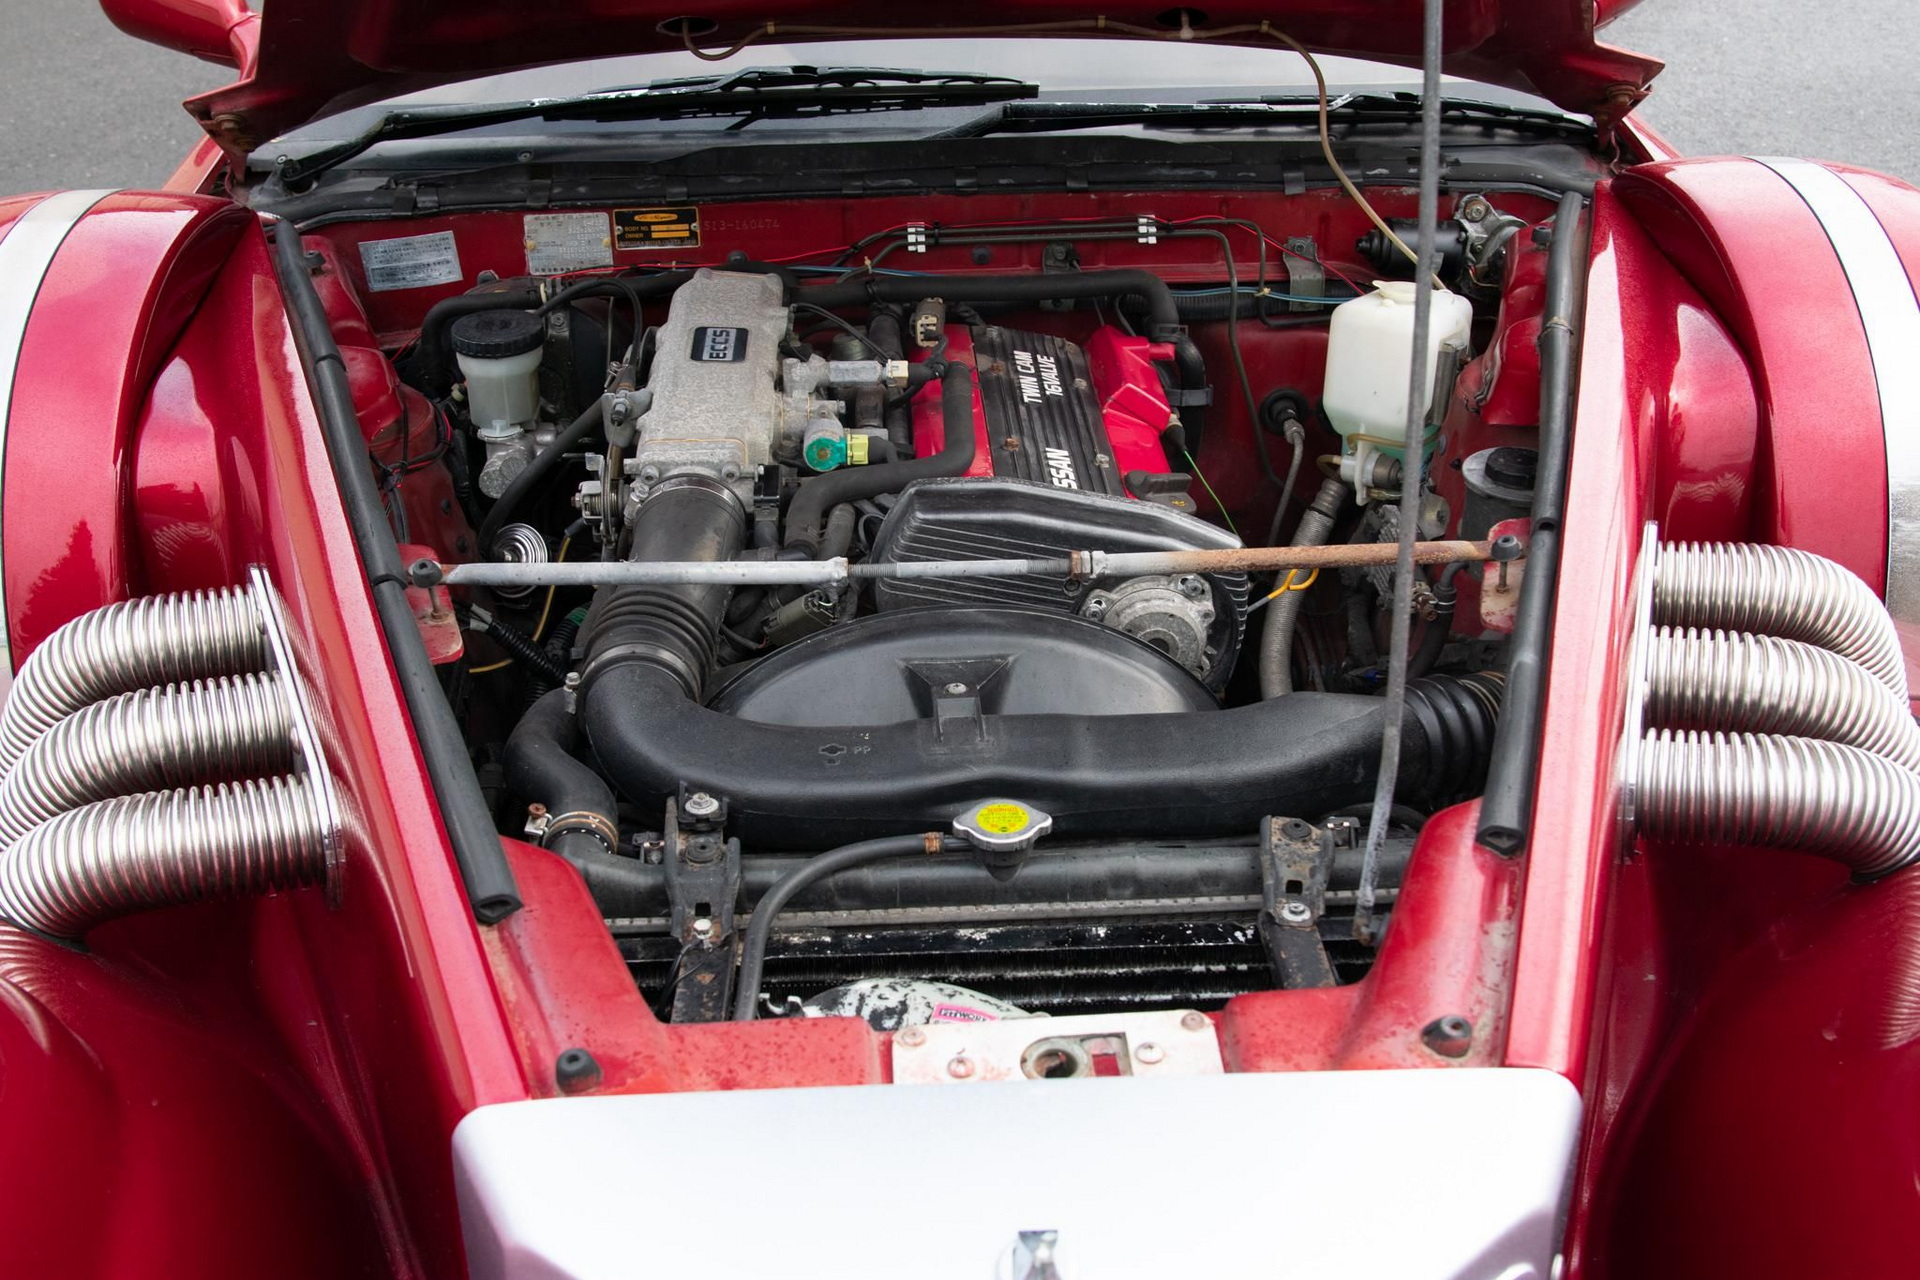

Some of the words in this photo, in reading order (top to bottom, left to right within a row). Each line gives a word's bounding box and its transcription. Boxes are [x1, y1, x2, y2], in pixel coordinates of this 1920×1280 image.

[709, 330, 730, 359] ECCS
[1013, 350, 1036, 373] CAM
[1036, 354, 1064, 397] 16VALVE
[1019, 375, 1042, 404] TWIN
[1045, 447, 1078, 490] SSAN
